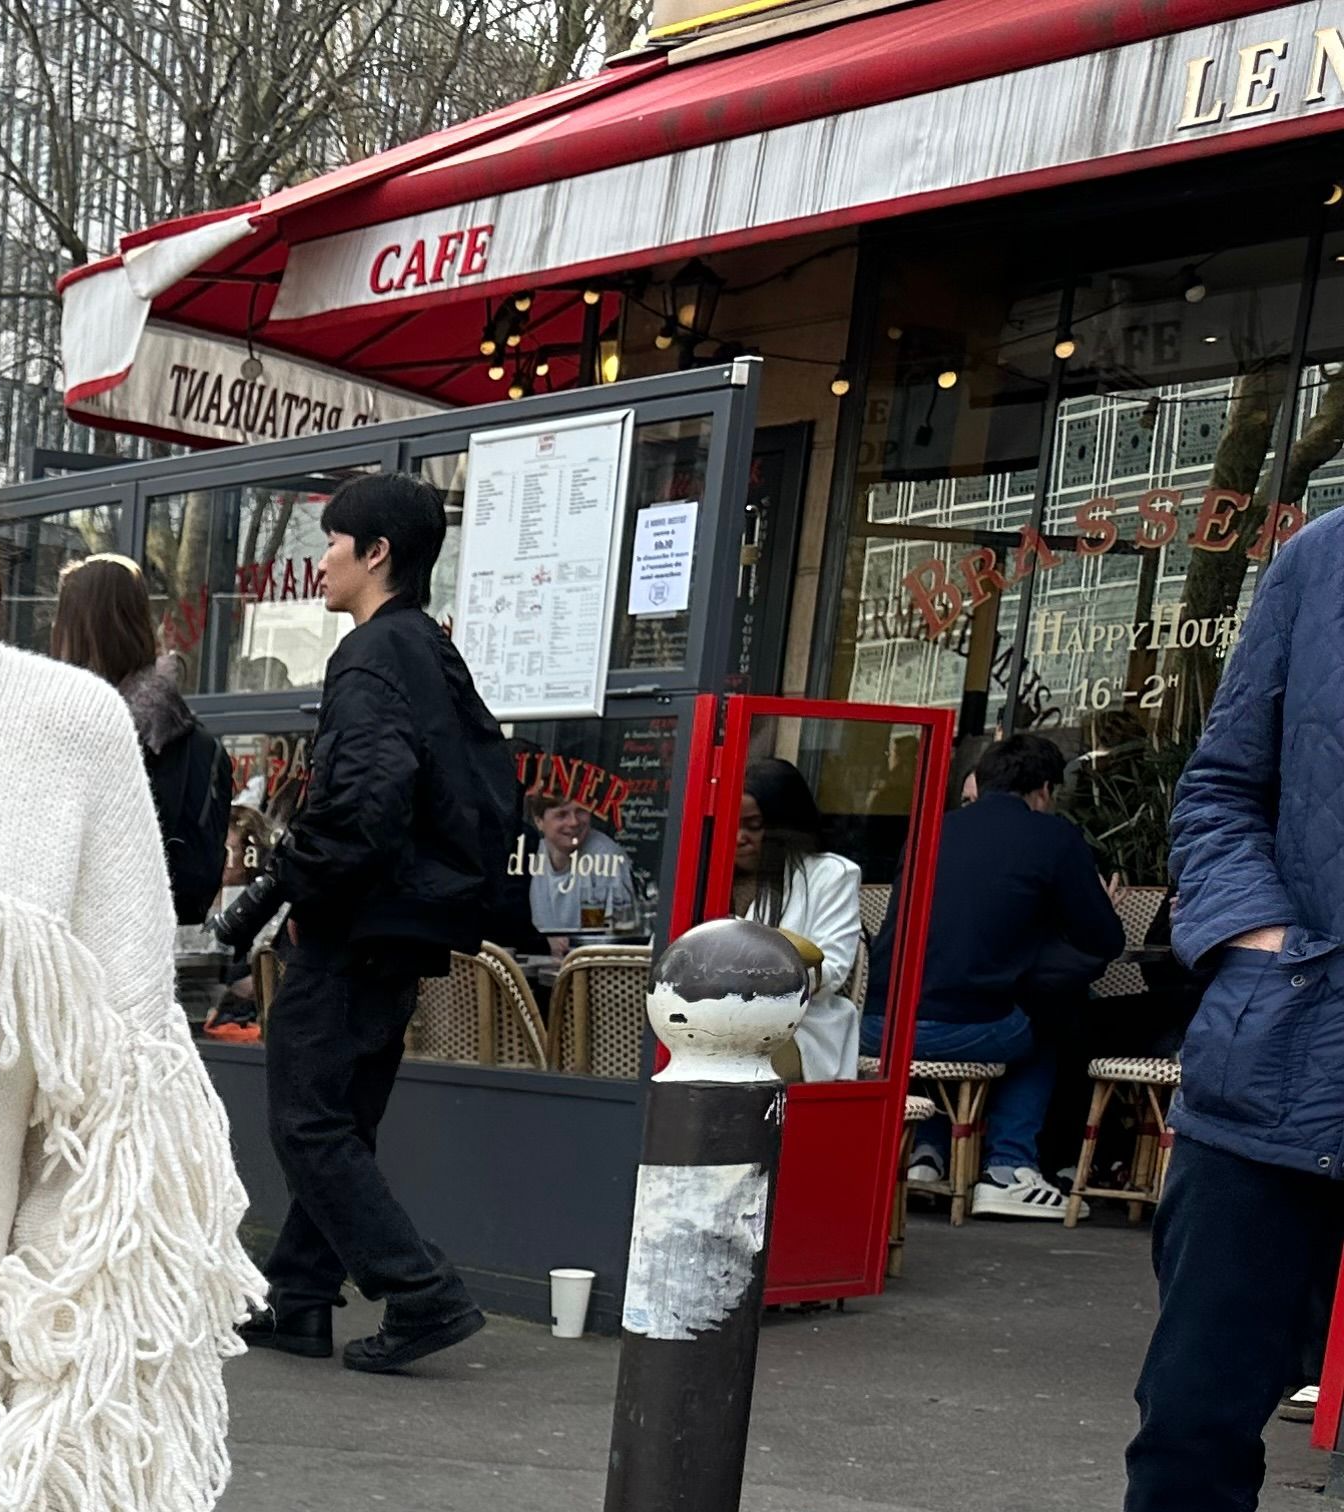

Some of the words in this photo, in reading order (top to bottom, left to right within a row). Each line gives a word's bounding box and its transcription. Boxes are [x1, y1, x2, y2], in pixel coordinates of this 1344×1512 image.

[1176, 38, 1289, 131] LE
[369, 224, 495, 295] CAFE
[902, 488, 1306, 641] BRASSER
[1032, 608, 1149, 657] HAPPY
[515, 752, 630, 833] UNER
[507, 833, 545, 877] du
[558, 837, 624, 894] jour
